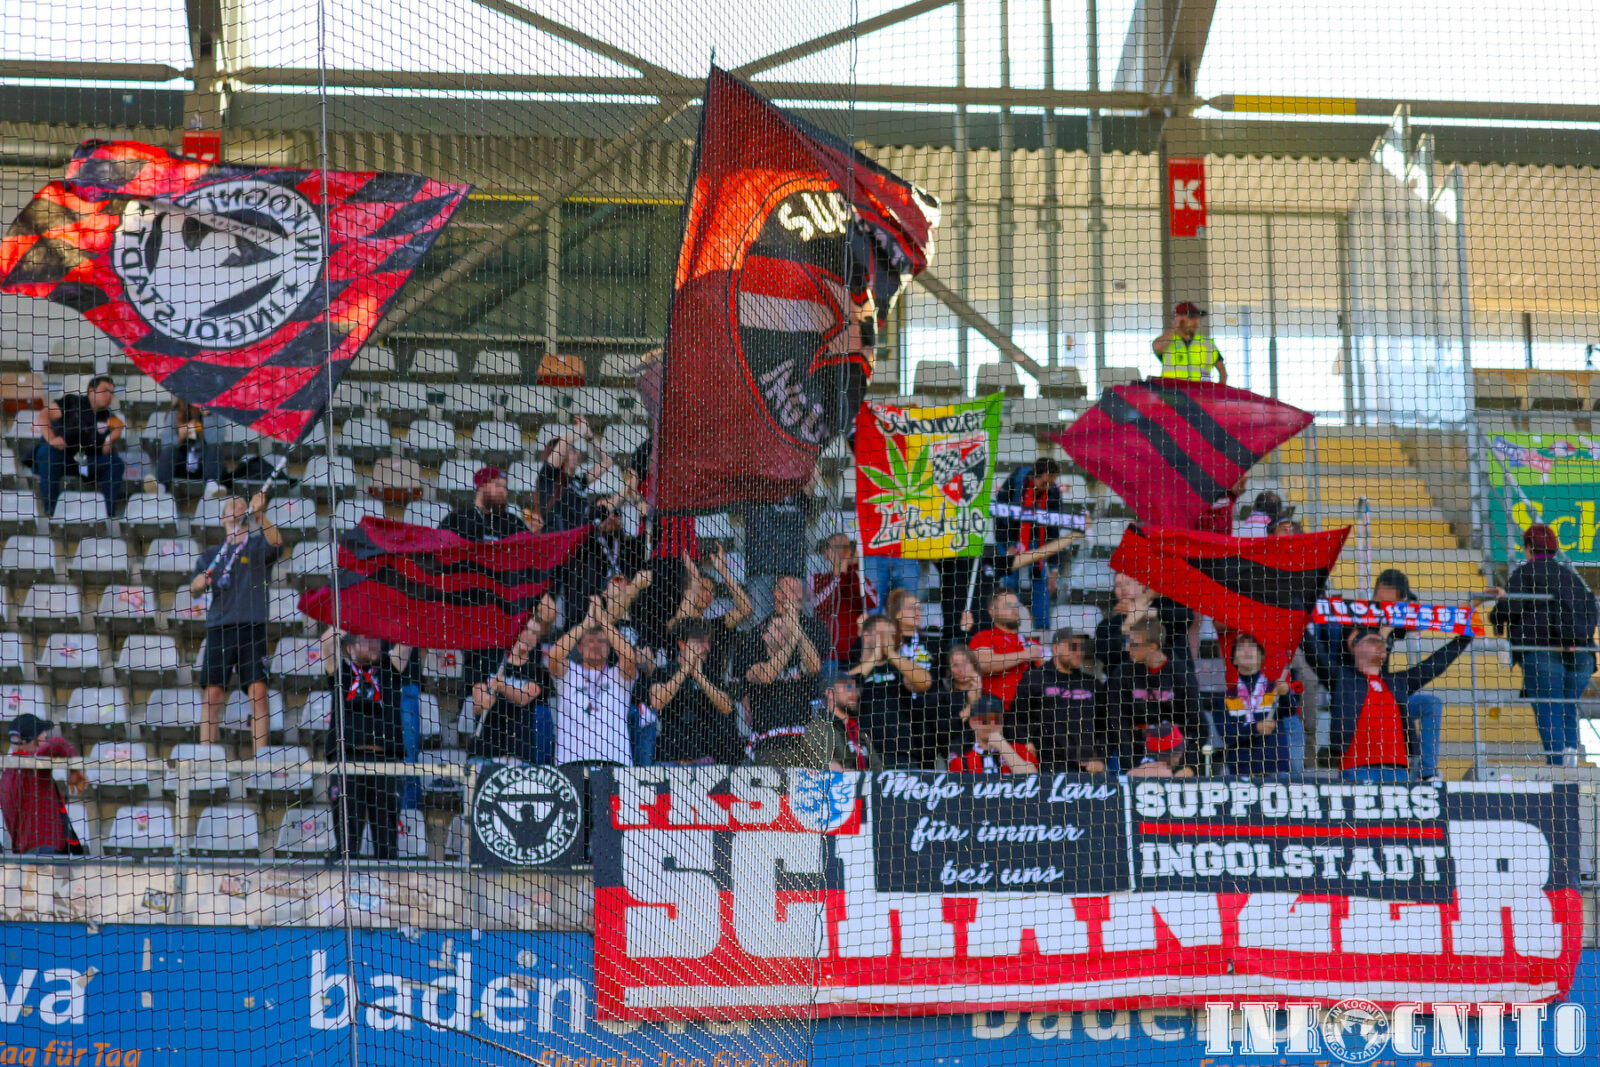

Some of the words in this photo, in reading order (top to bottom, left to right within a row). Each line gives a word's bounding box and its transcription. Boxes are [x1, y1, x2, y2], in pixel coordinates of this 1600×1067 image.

[1173, 179, 1202, 210] K
[499, 767, 572, 802] KOGNITO
[878, 770, 965, 812] Mofo
[973, 772, 1041, 801] und
[1047, 771, 1117, 804] Lars
[1135, 781, 1441, 820] SUPPORTERS
[480, 823, 572, 860] INGOLSTADT
[911, 814, 967, 852] für
[976, 818, 1085, 843] immer
[940, 858, 991, 886] bei
[1000, 862, 1064, 886] uns
[1139, 841, 1446, 881] INGOLSTADT
[0, 1041, 37, 1067] ag
[43, 1039, 88, 1067] für
[93, 1042, 142, 1067] Tag
